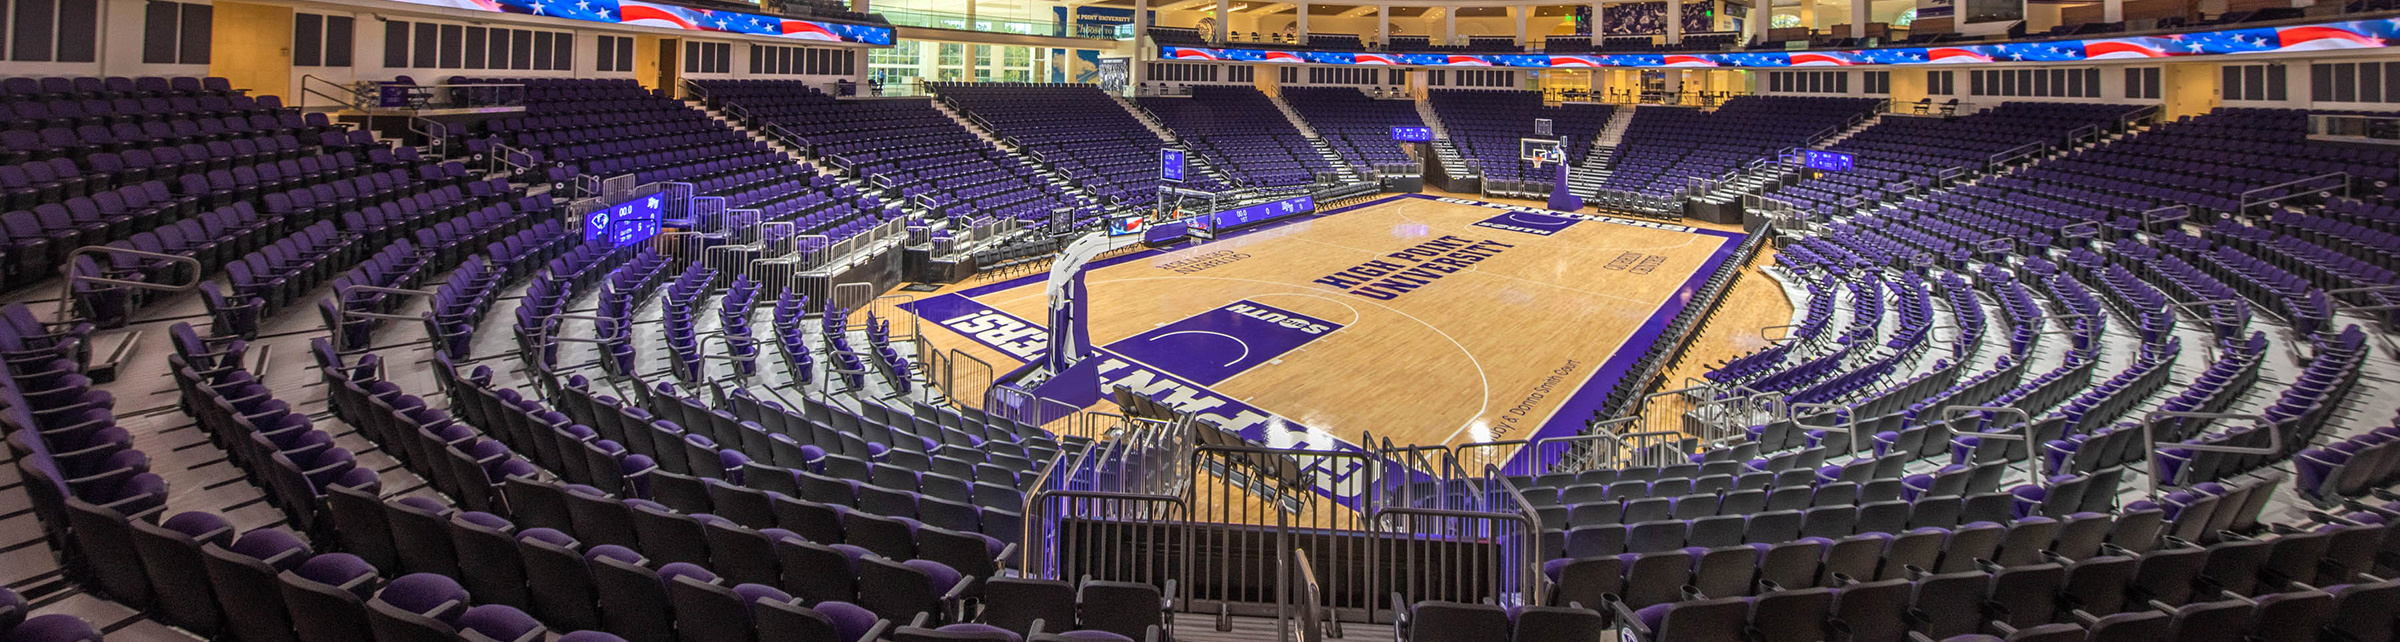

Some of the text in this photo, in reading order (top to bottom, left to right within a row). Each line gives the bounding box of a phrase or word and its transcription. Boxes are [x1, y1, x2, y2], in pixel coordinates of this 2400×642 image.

[1478, 222, 1552, 234] SOUTH
[1312, 235, 1474, 290] HIGH POINT
[1349, 240, 1515, 300] UNIVERSITY
[1225, 304, 1330, 334] SOUTH
[1509, 392, 1544, 416] Donna
[1534, 374, 1563, 394] Smith
